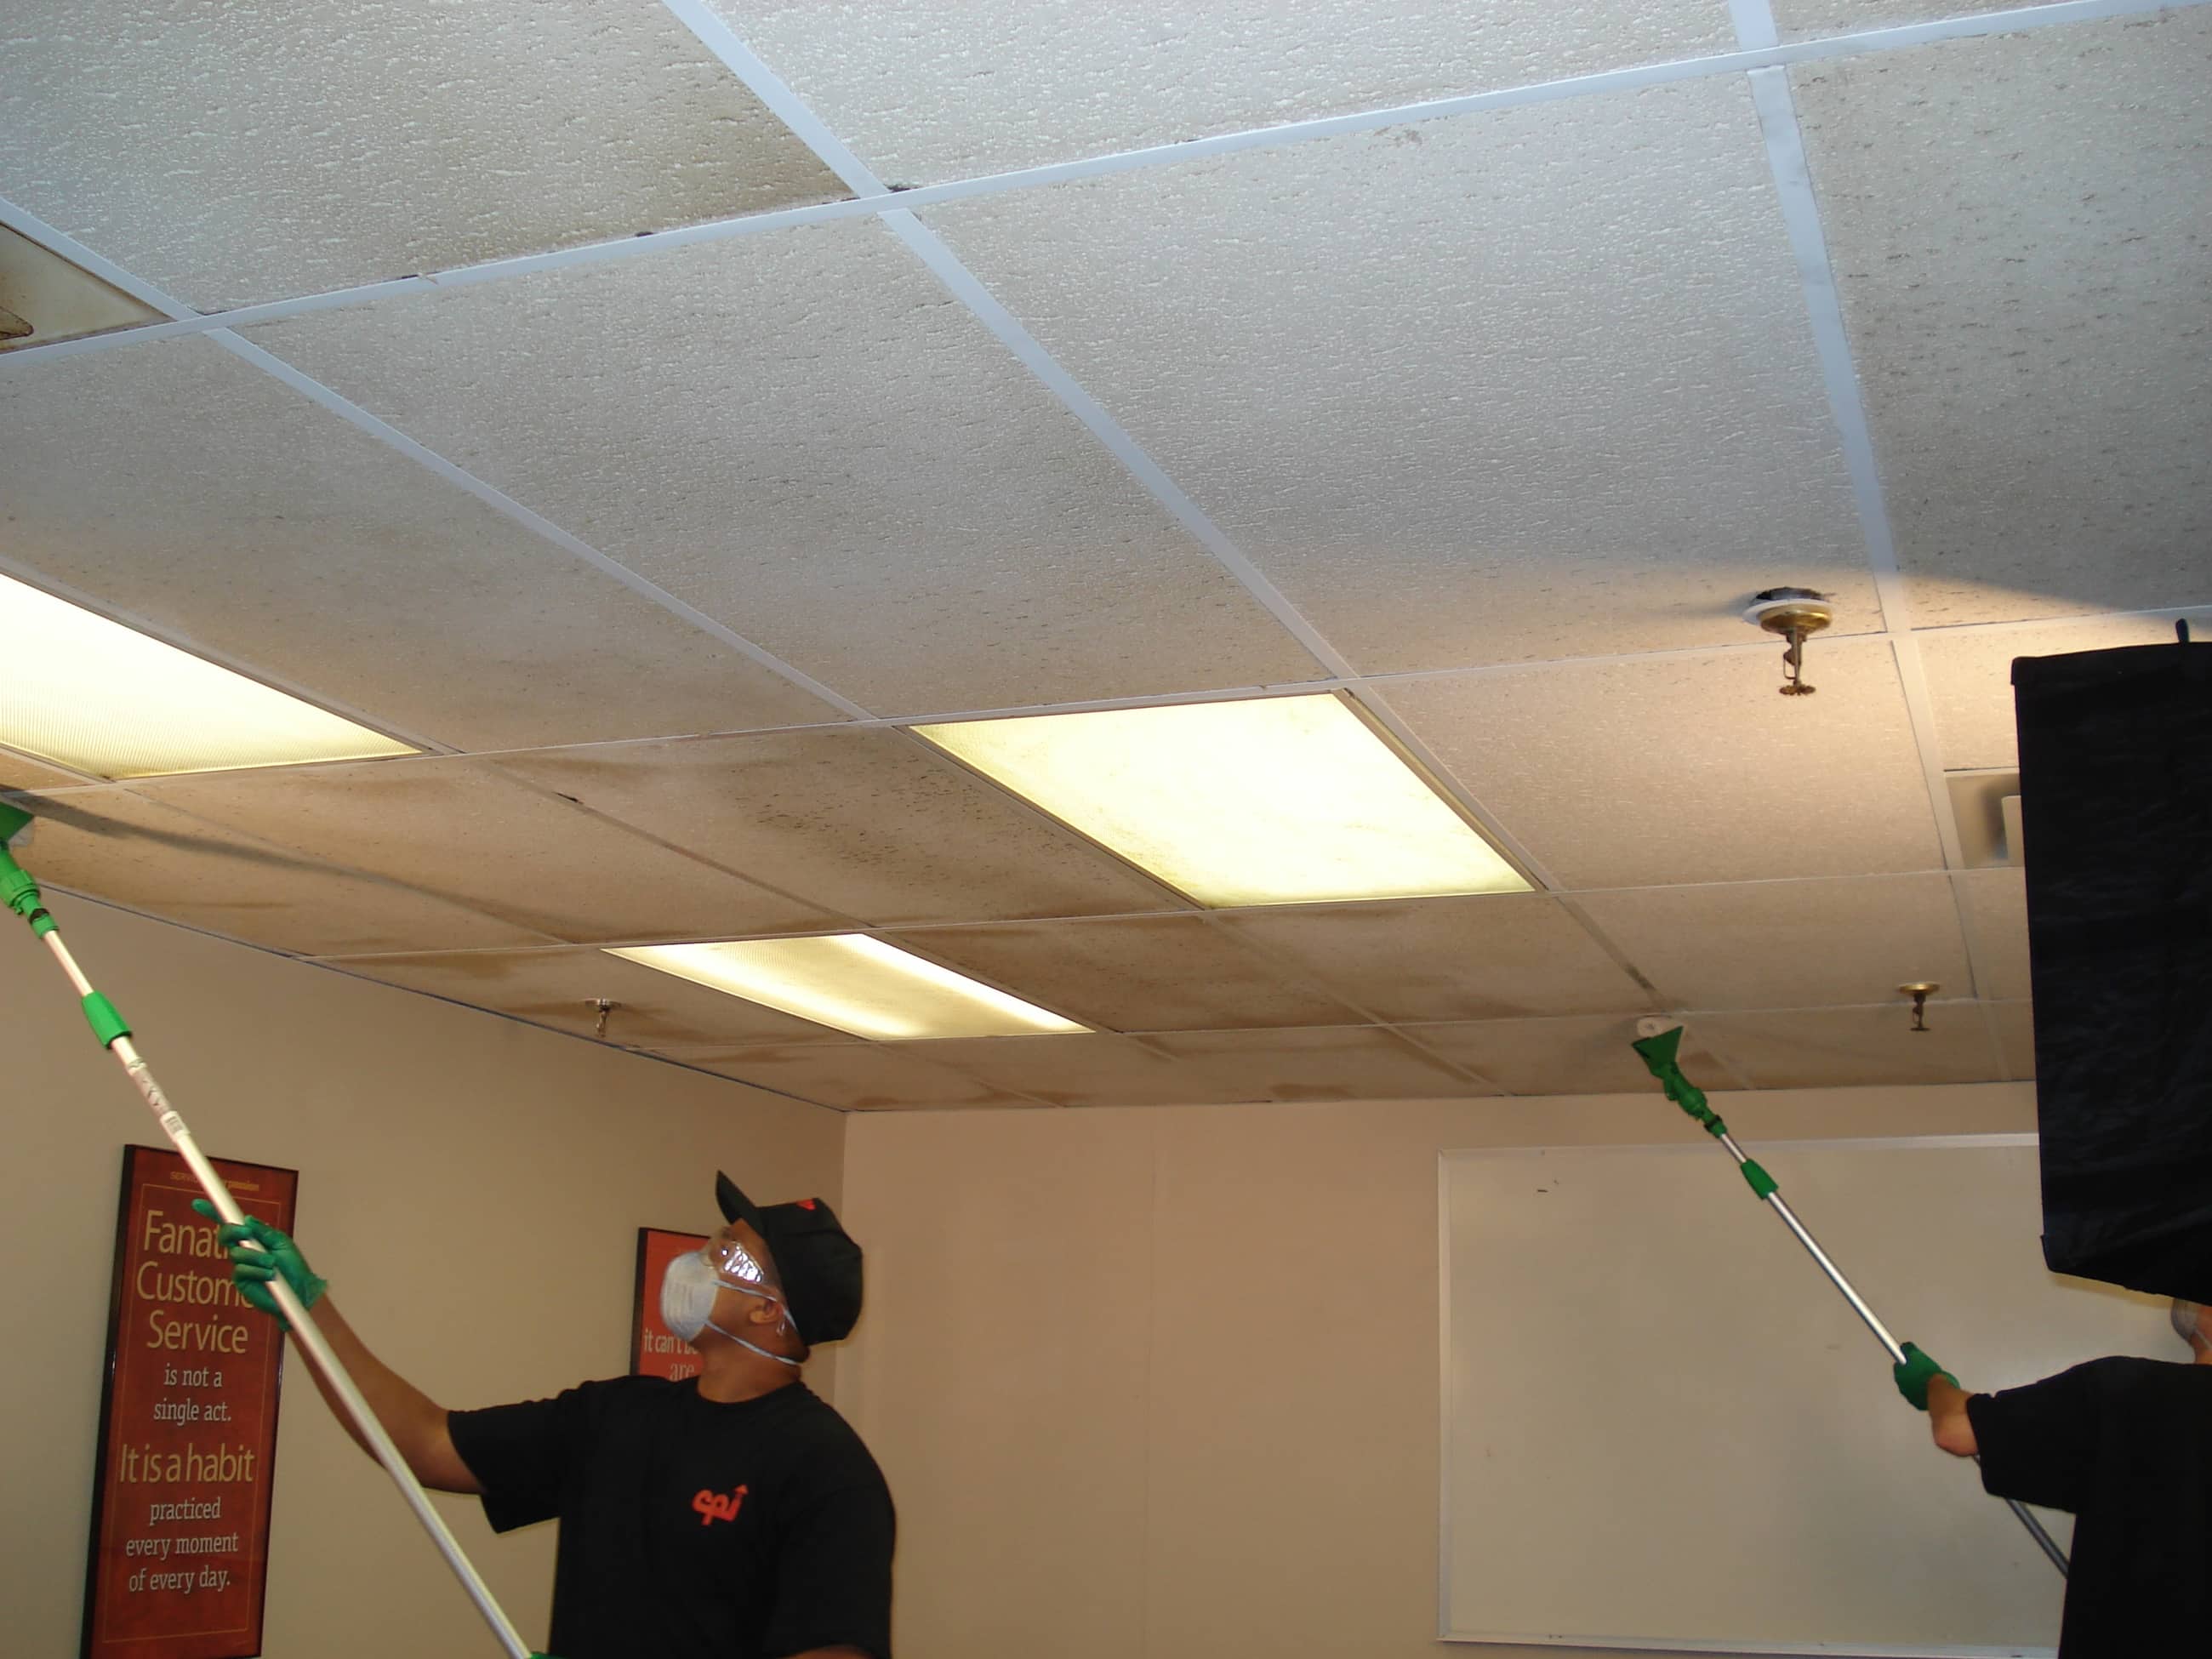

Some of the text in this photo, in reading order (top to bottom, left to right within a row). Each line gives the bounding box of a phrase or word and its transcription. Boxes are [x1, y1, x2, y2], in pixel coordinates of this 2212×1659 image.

[145, 1309, 248, 1354] Service
[643, 1327, 653, 1354] it
[655, 1334, 682, 1354] cant
[163, 1363, 223, 1388] is not a
[153, 1398, 231, 1426] single act.
[119, 1443, 255, 1483] It is a habit
[149, 1497, 222, 1525] practiced
[126, 1532, 239, 1560] every moment
[128, 1565, 231, 1593] of every day.
